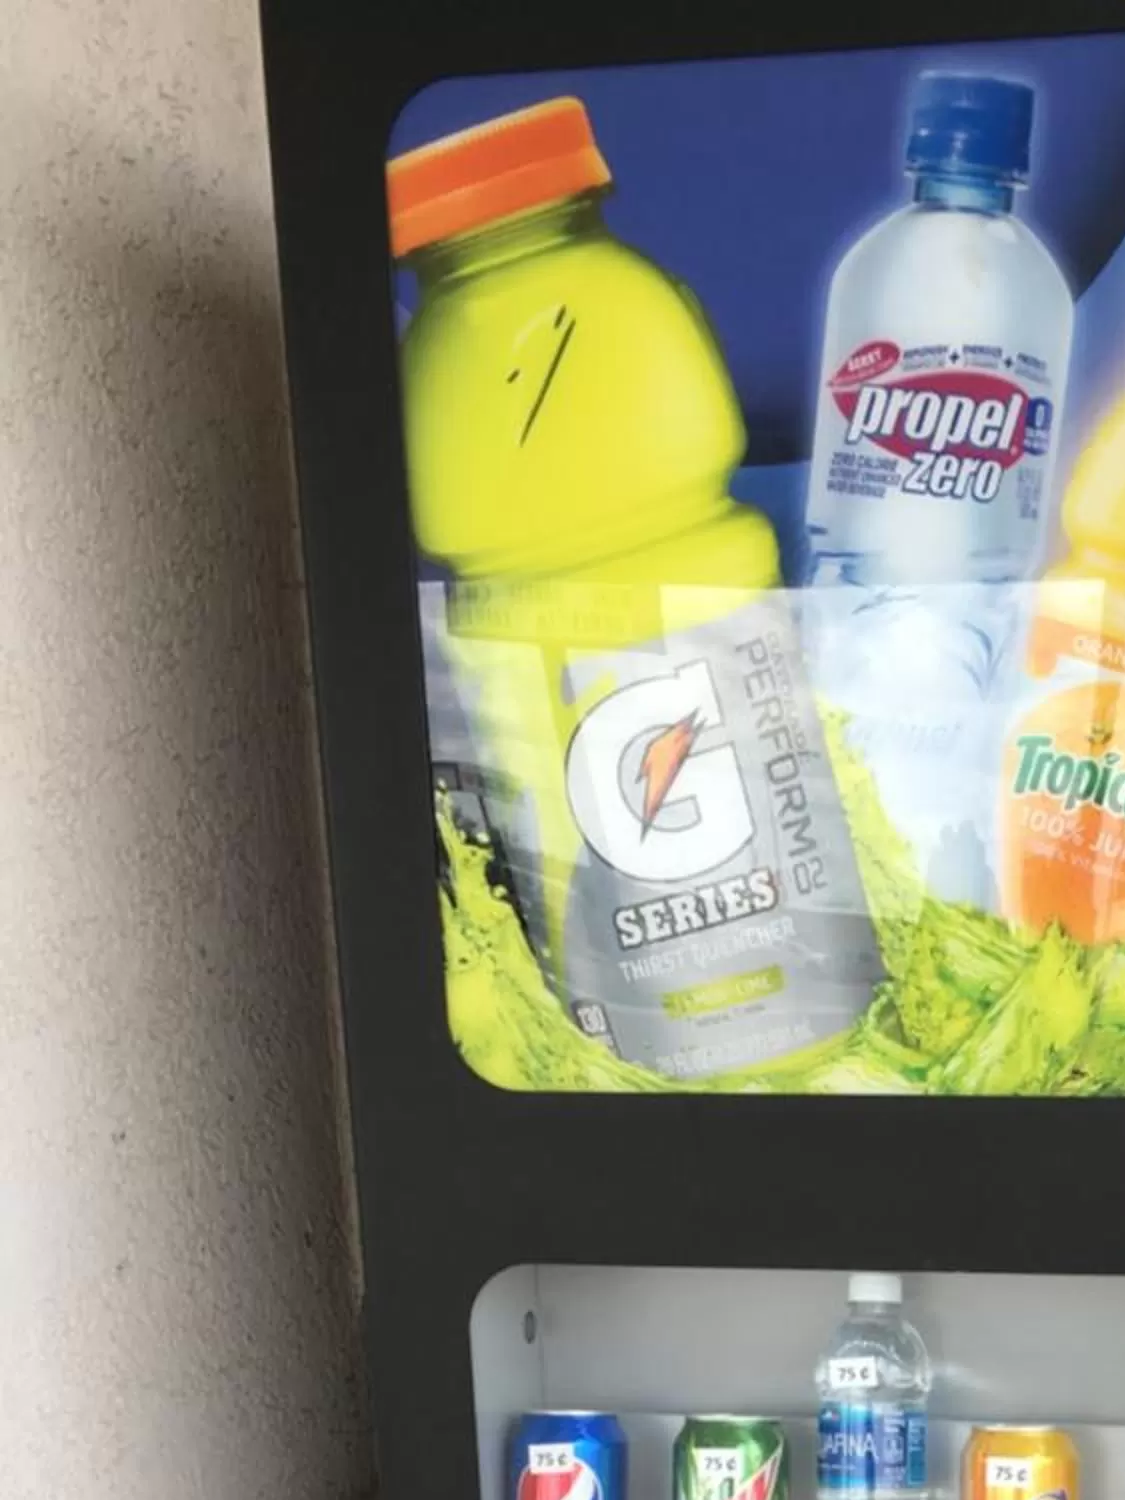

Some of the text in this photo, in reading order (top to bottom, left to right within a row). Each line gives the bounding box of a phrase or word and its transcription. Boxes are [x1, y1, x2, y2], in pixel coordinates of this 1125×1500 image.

[845, 384, 1024, 452] propel
[901, 451, 1004, 503] zero
[565, 659, 755, 884] G
[614, 866, 778, 950] SERIES
